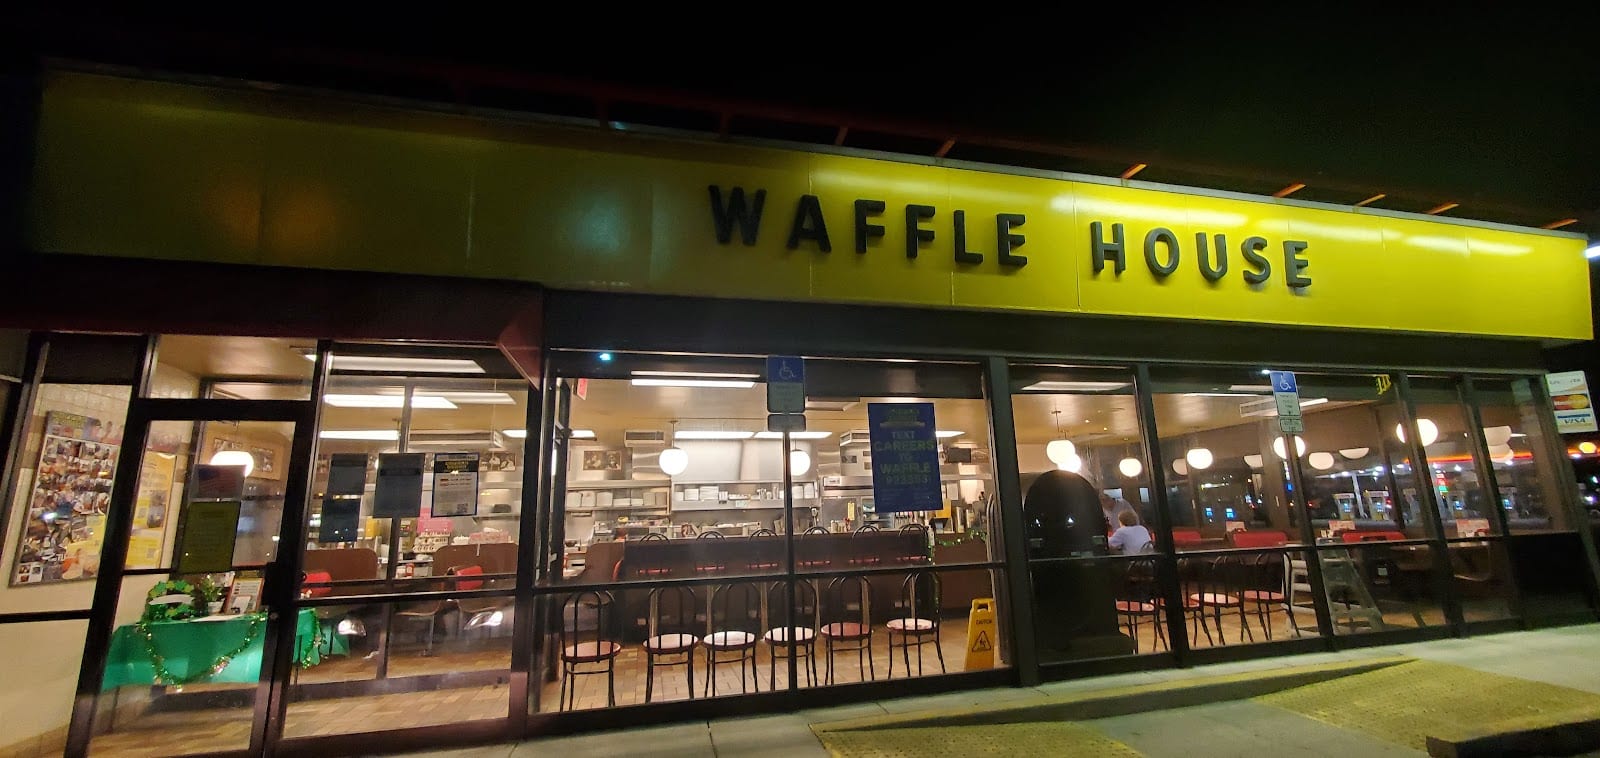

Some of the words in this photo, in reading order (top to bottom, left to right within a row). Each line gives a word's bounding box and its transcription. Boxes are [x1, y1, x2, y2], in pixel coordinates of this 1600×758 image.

[708, 185, 1028, 268] WAFFLE
[1090, 221, 1312, 289] HOUSE
[891, 430, 915, 439] TEXT
[873, 439, 935, 451] CAREERS
[880, 462, 931, 474] WAFFLE
